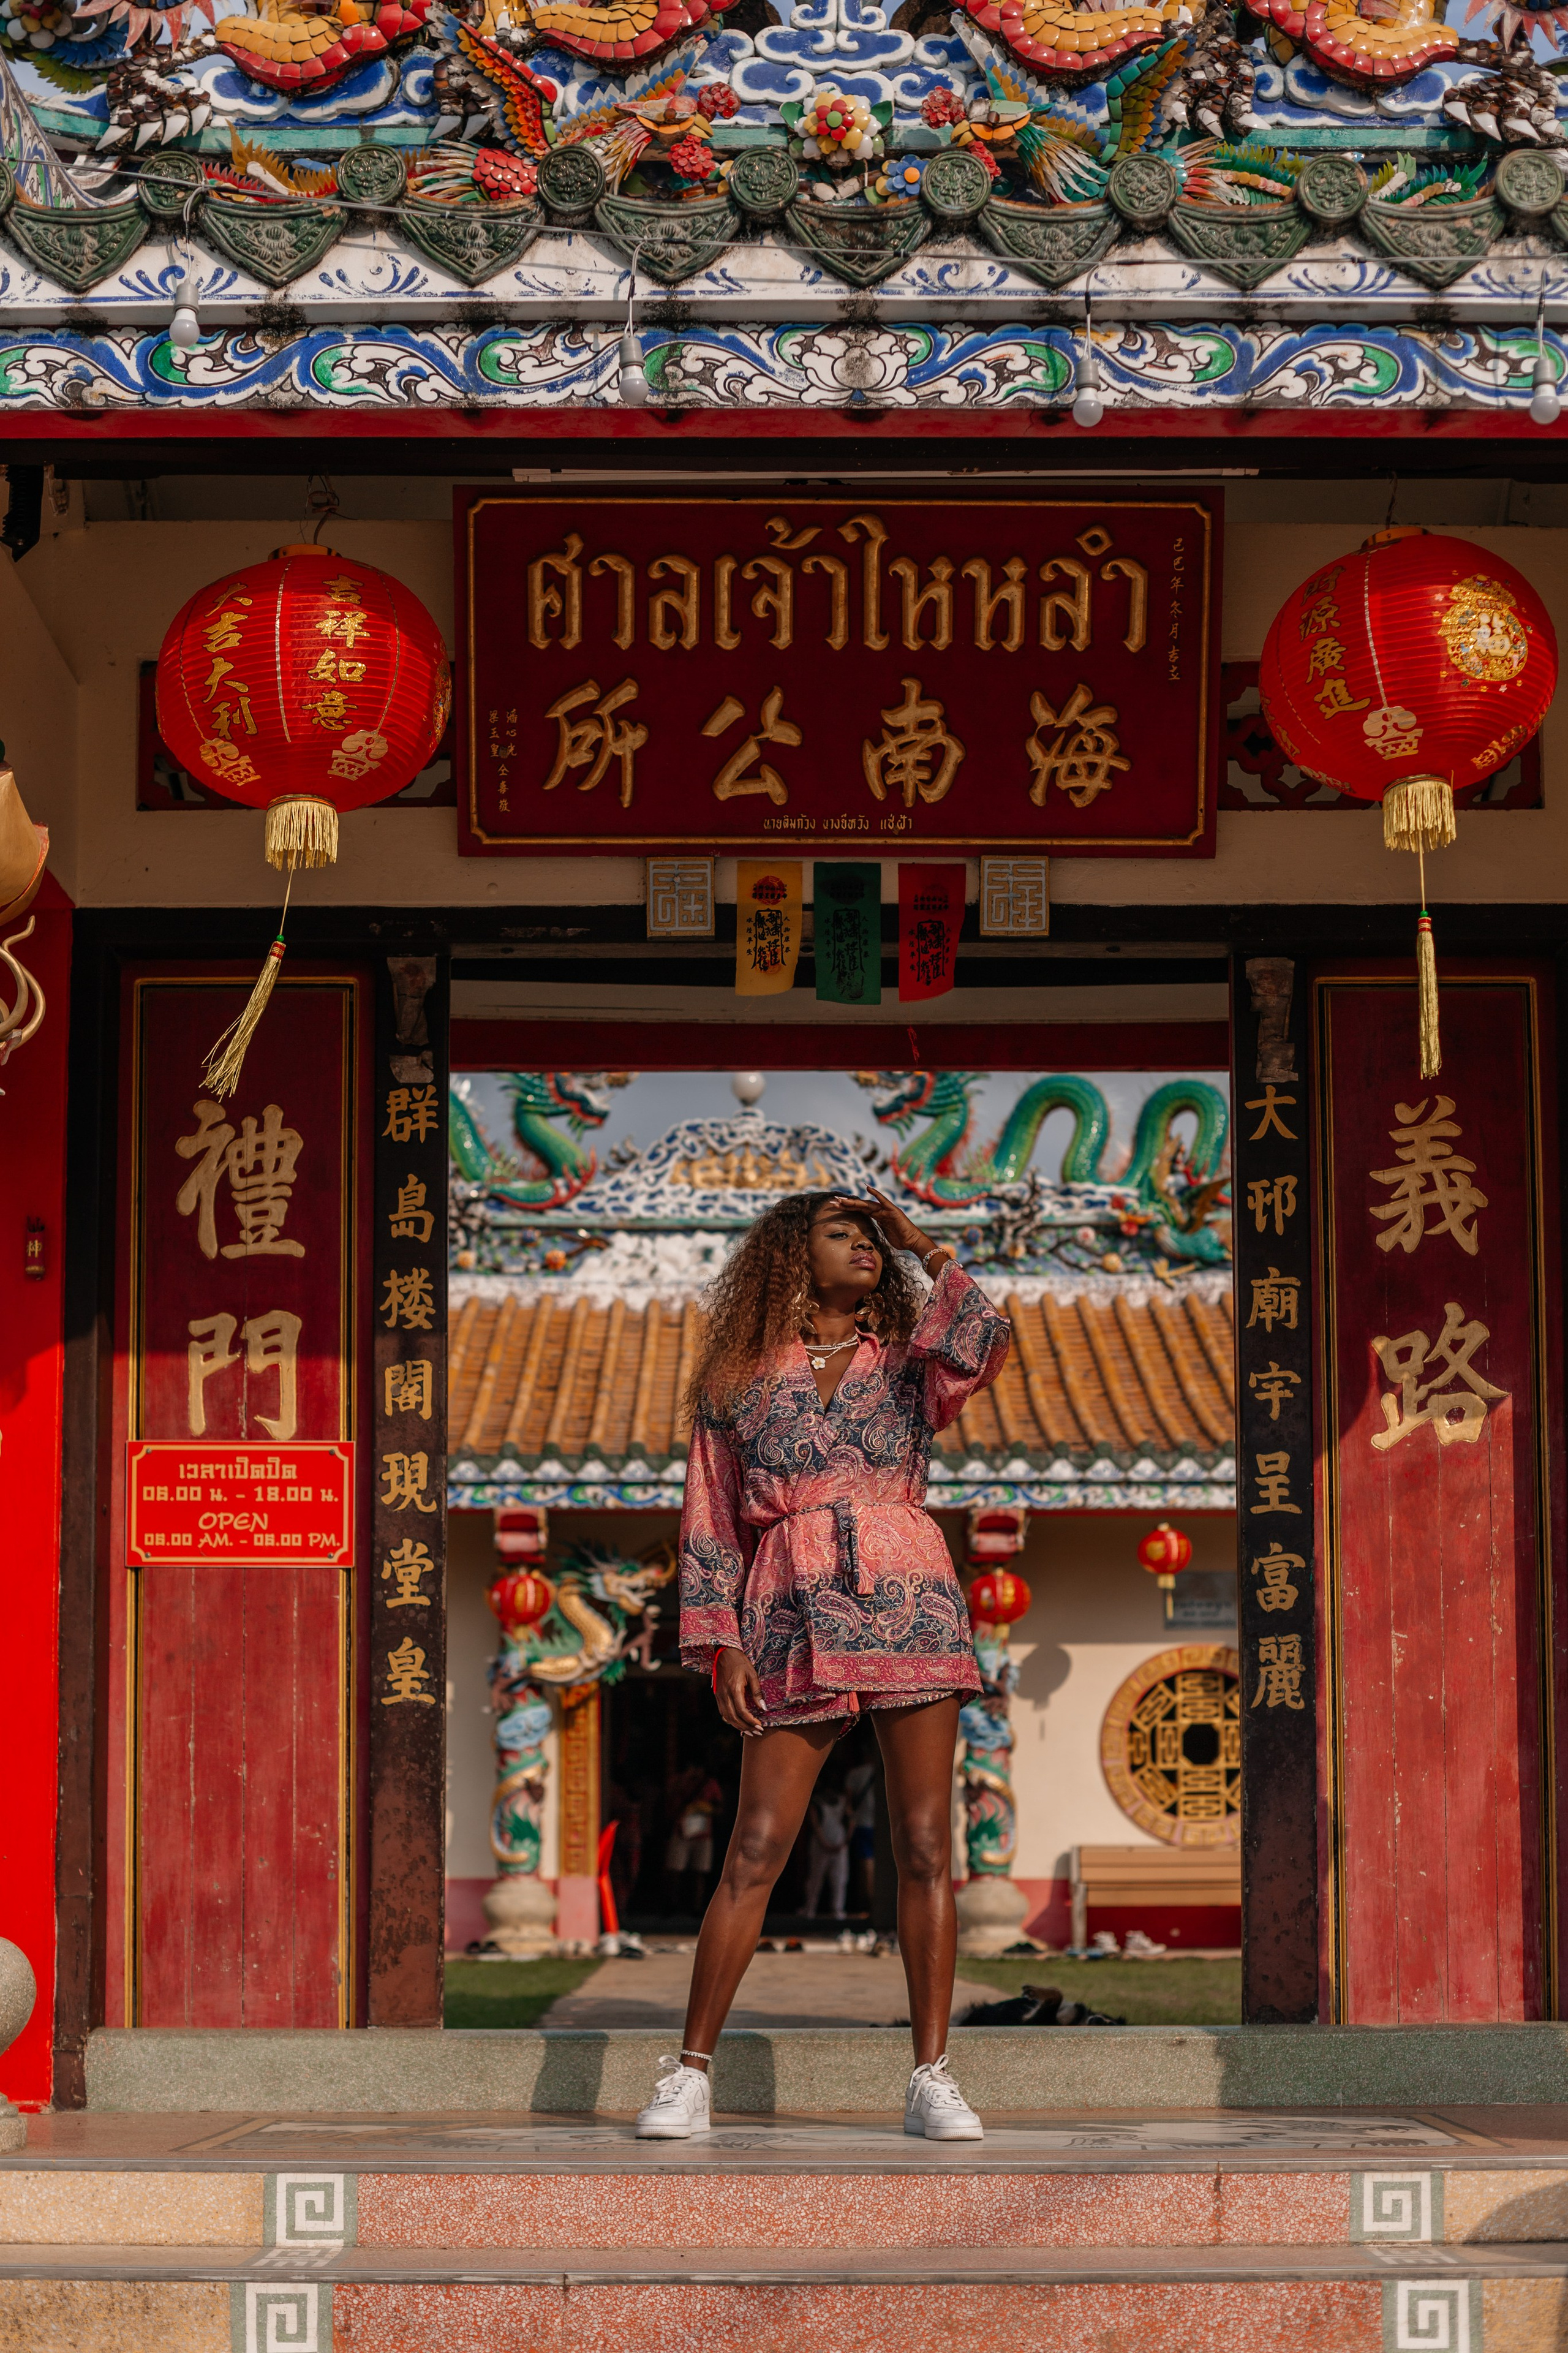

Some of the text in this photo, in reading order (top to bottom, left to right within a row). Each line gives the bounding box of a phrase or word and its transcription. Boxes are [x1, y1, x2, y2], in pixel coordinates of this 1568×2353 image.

[527, 513, 1148, 654] ศาลเจ้าไหหลำ
[202, 581, 258, 740] 大吉大利
[301, 575, 371, 730] 吉祥如意
[1369, 1095, 1510, 1451] 義路
[179, 1456, 298, 1479] เวลาเปิดปิด
[254, 1486, 313, 1502] 18.00
[197, 1532, 233, 1548] AM.
[307, 1532, 341, 1549] PM.
[198, 1511, 268, 1533] OPEN
